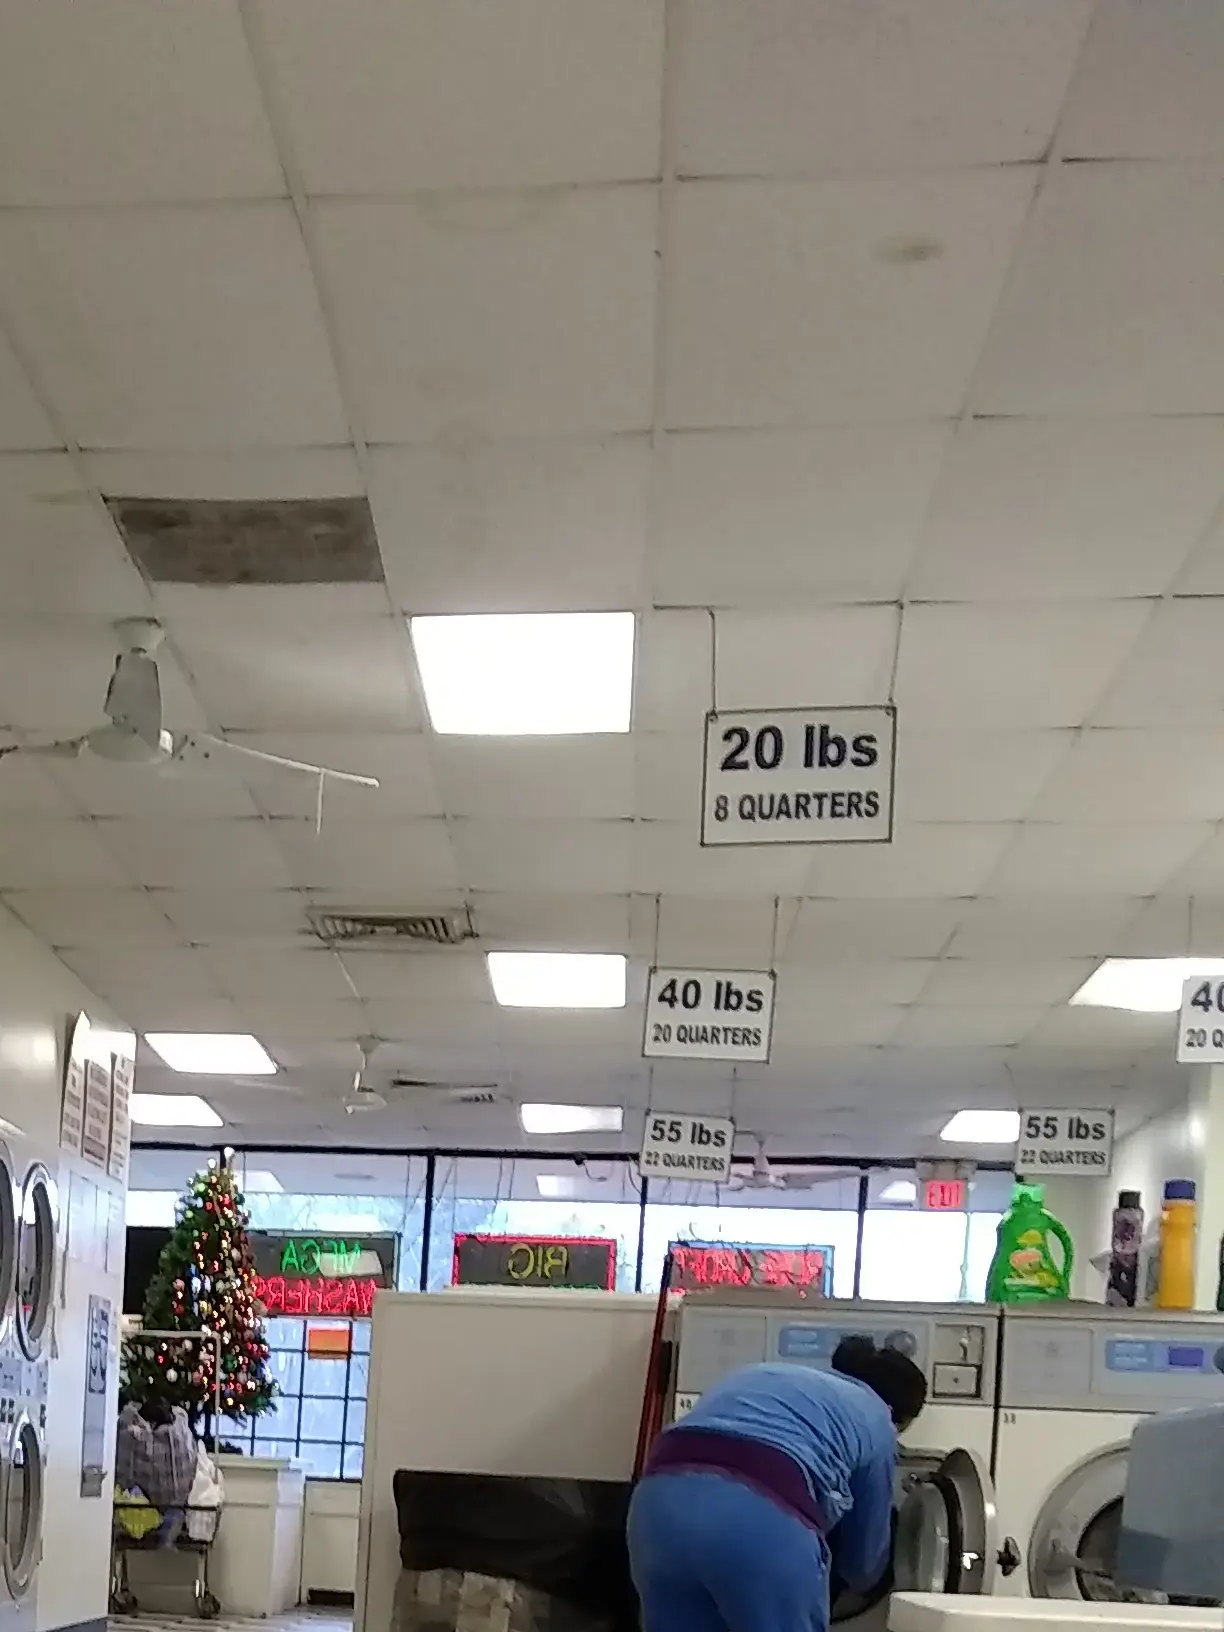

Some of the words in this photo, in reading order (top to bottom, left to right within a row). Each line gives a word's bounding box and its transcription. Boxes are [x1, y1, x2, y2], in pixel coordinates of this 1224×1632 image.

[721, 724, 784, 772] 20
[803, 723, 878, 768] lbs
[714, 794, 729, 822] 8
[738, 790, 880, 823] QUARTERS
[657, 978, 702, 1009] 40
[714, 979, 764, 1012] lbs
[652, 1023, 672, 1043] 20
[676, 1024, 762, 1047] QUARTERS
[1186, 1028, 1207, 1048] 20
[650, 1118, 682, 1143] 55
[690, 1121, 727, 1148] lbs
[1025, 1115, 1058, 1140] 55
[1068, 1115, 1106, 1141] lbs
[662, 1152, 726, 1172] QUARTERS
[1039, 1150, 1106, 1166] QUARTERS
